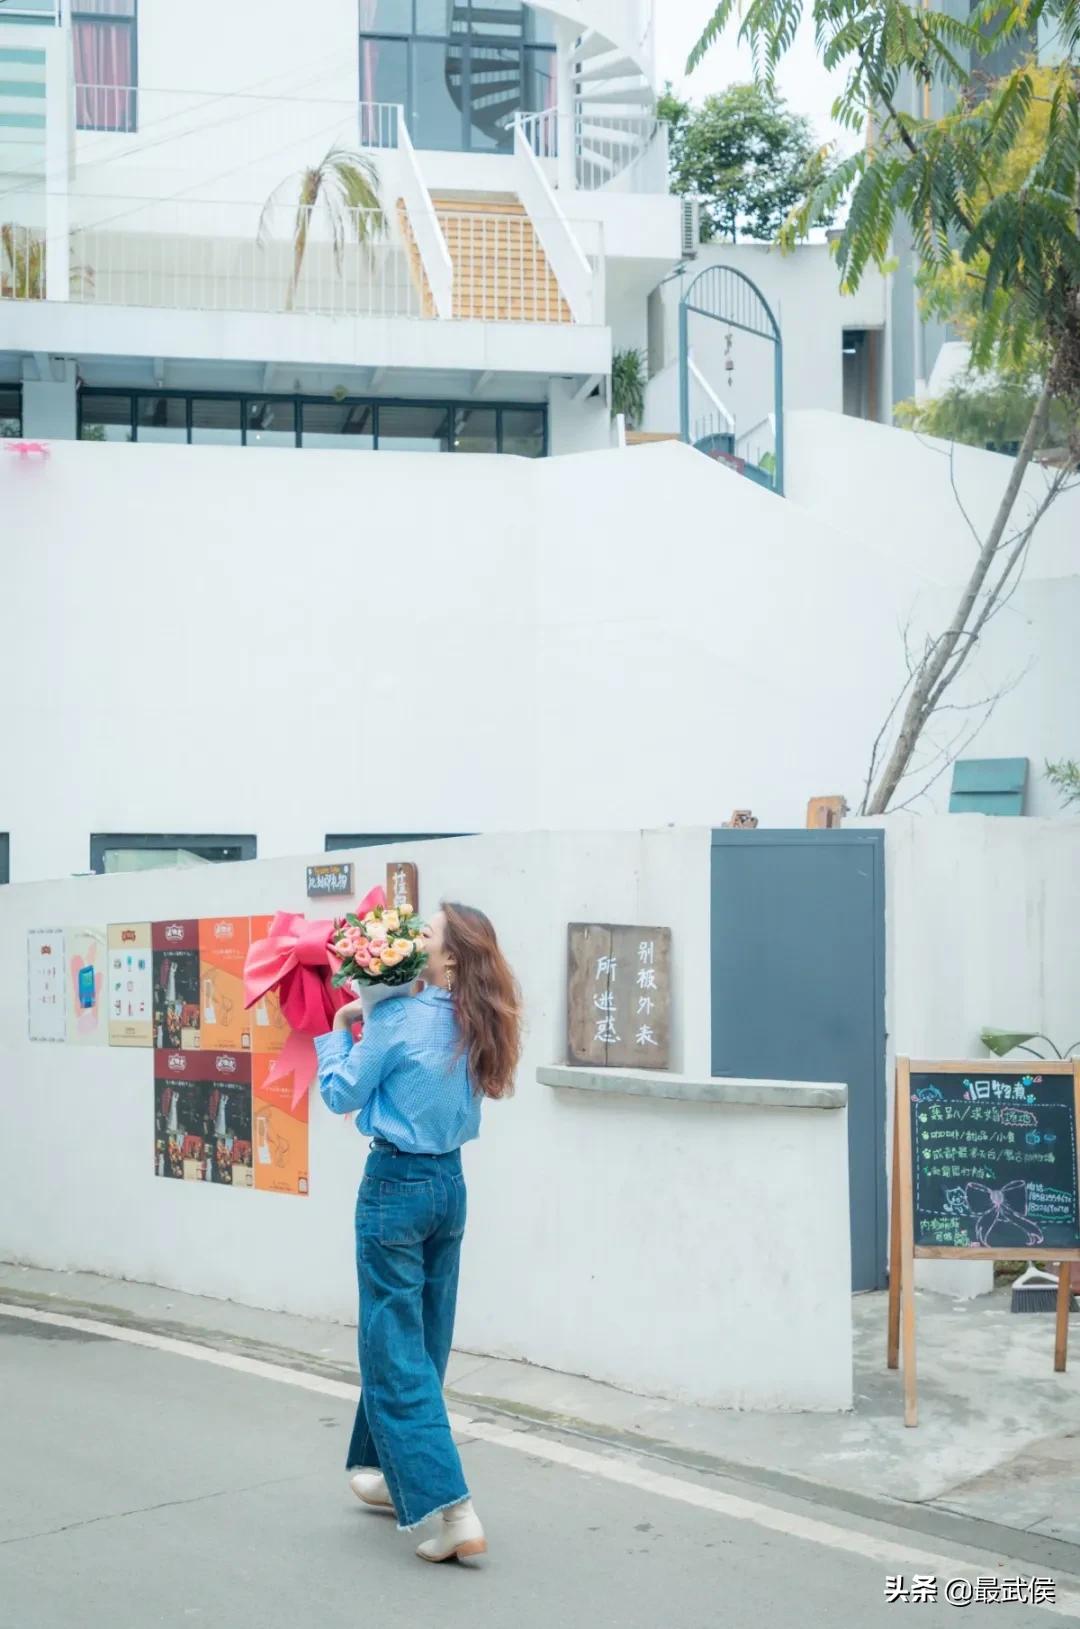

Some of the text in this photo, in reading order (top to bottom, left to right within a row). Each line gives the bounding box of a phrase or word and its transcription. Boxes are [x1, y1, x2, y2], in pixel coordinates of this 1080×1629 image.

[593, 955, 622, 1043] 所迷惑
[635, 941, 658, 1046] 别被外表
